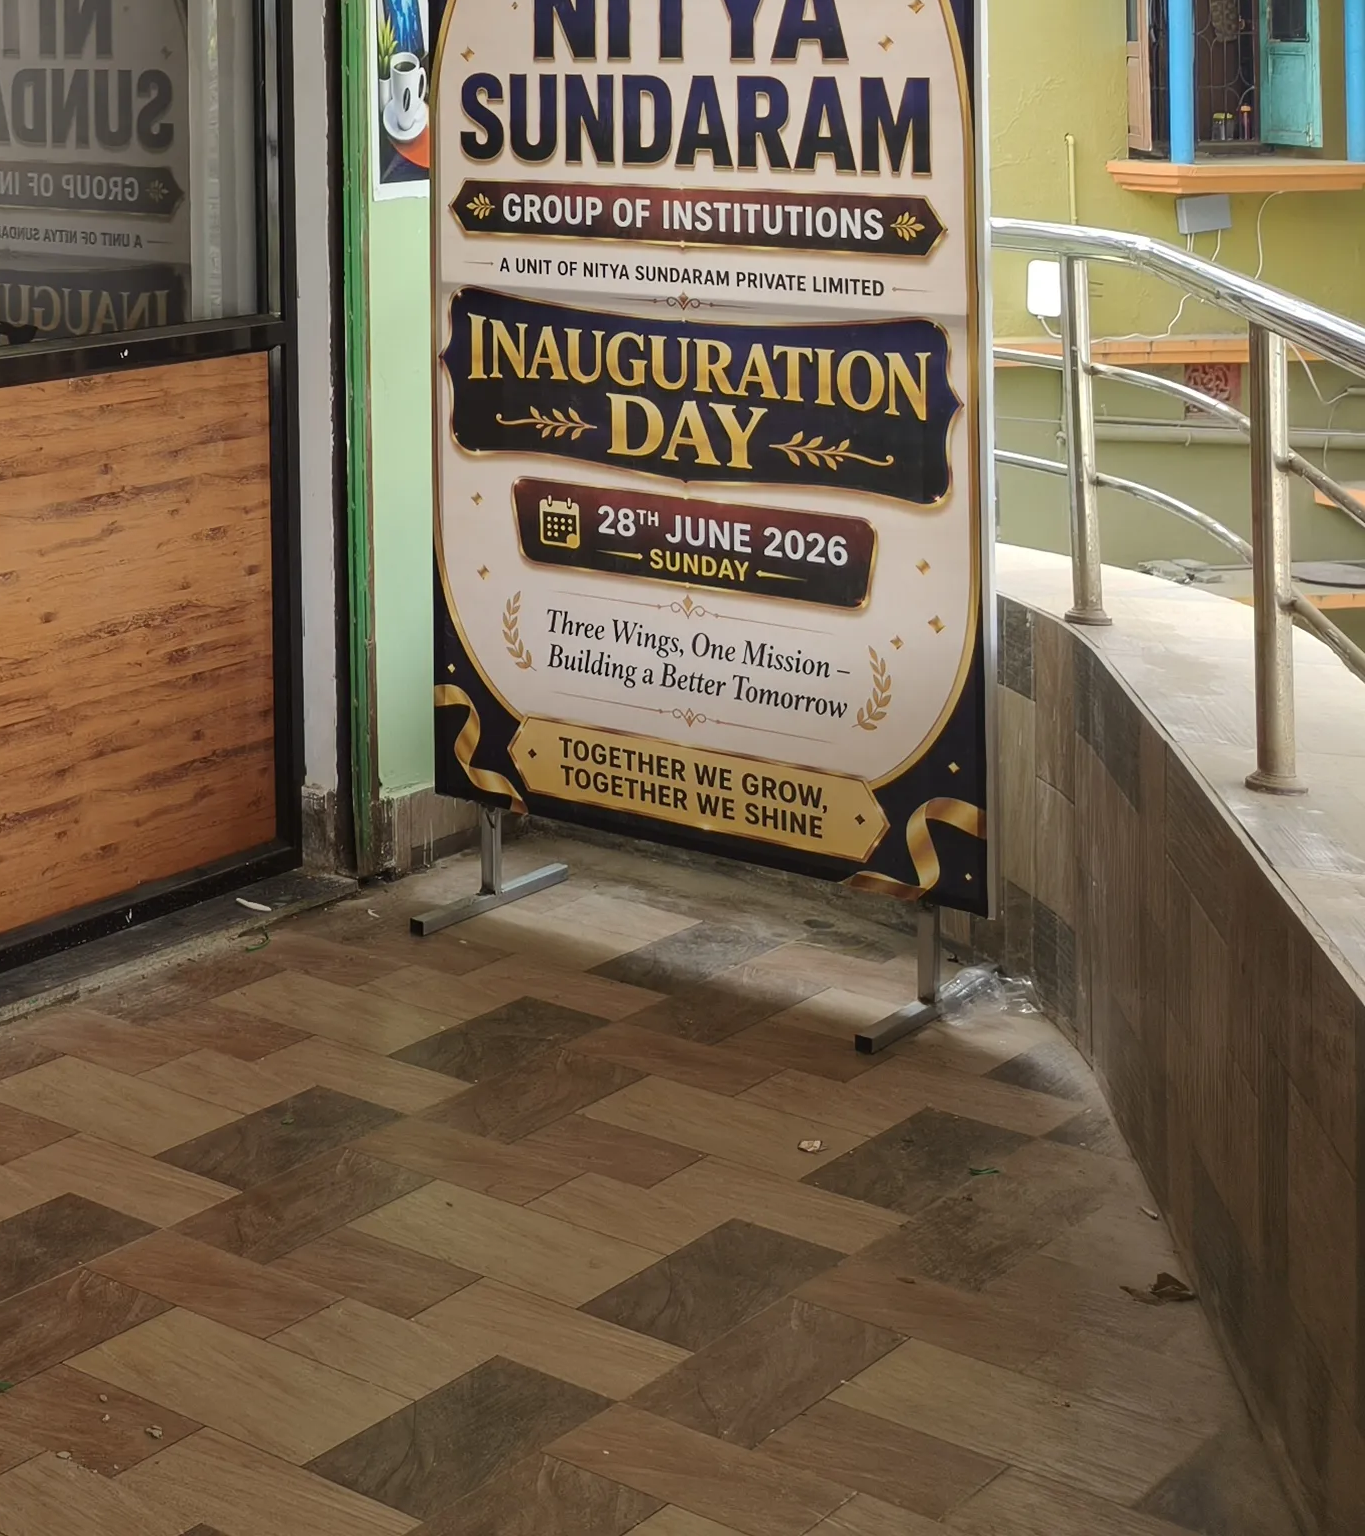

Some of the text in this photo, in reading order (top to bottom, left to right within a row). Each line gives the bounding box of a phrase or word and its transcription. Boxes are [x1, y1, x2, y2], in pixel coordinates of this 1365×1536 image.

[460, 72, 933, 177] SUNDARAM
[502, 193, 884, 241] GROUP OF INSTITUTIONS
[500, 257, 884, 297] A UNIT OF NITYA SUNDARAM PRIVATE LIMITED
[467, 313, 932, 421] INAUGURATION
[606, 392, 768, 469] DAY
[650, 548, 749, 582] SUNDAY
[665, 514, 752, 554] JUNE
[763, 526, 848, 566] 2026
[547, 608, 830, 678] Three Wings, One Mission
[547, 644, 848, 719] Building a Better Tomorrow
[559, 736, 828, 813] TOGETHER WE GROW,
